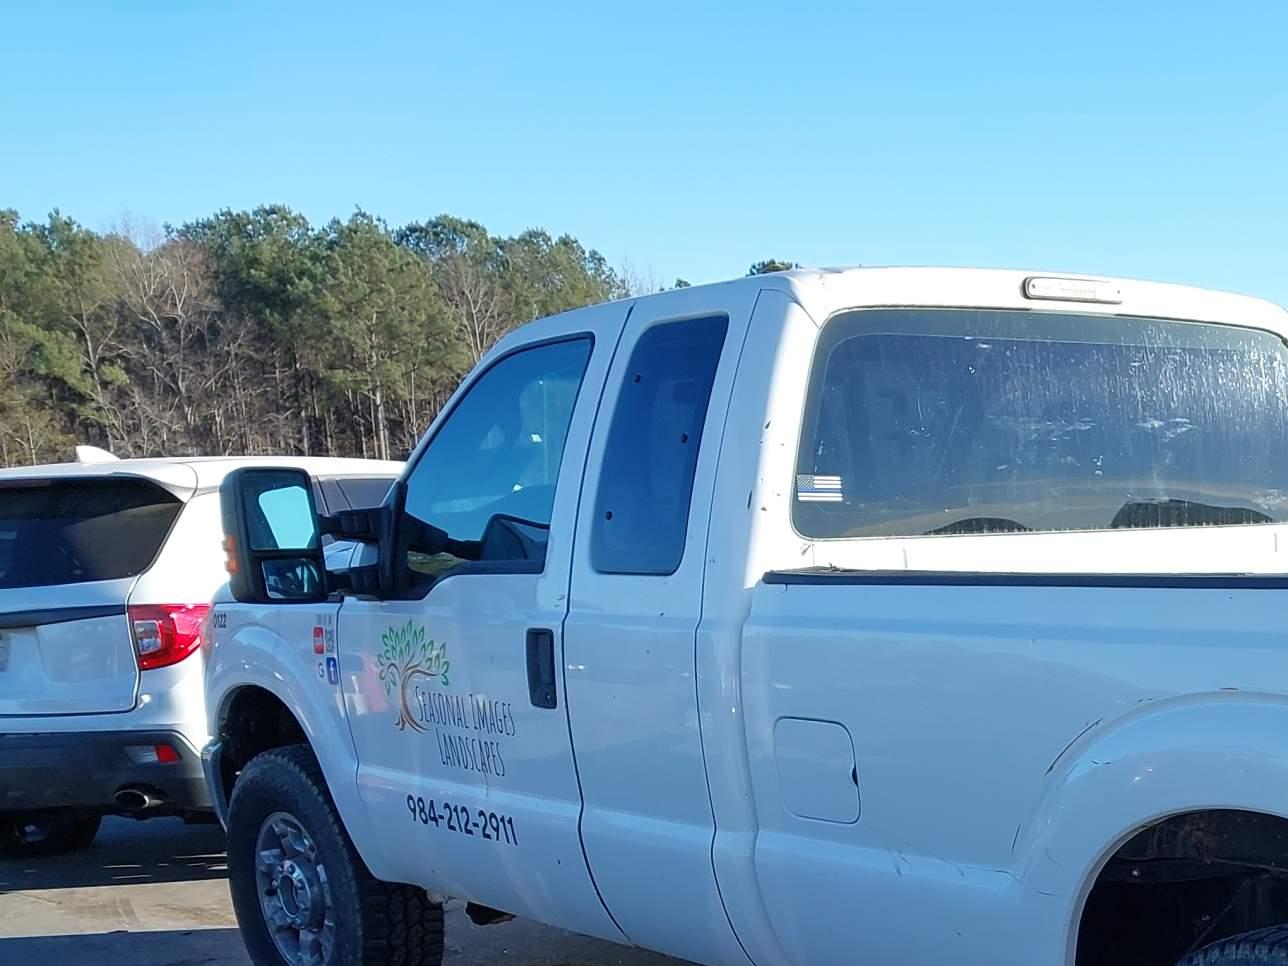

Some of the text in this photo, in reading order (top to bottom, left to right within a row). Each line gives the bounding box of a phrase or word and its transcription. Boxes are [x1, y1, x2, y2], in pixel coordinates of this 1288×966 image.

[415, 685, 515, 736] SEASONAL IMAGES
[435, 727, 505, 777] LANDSCAPES
[406, 794, 518, 846] 984-212-2911
